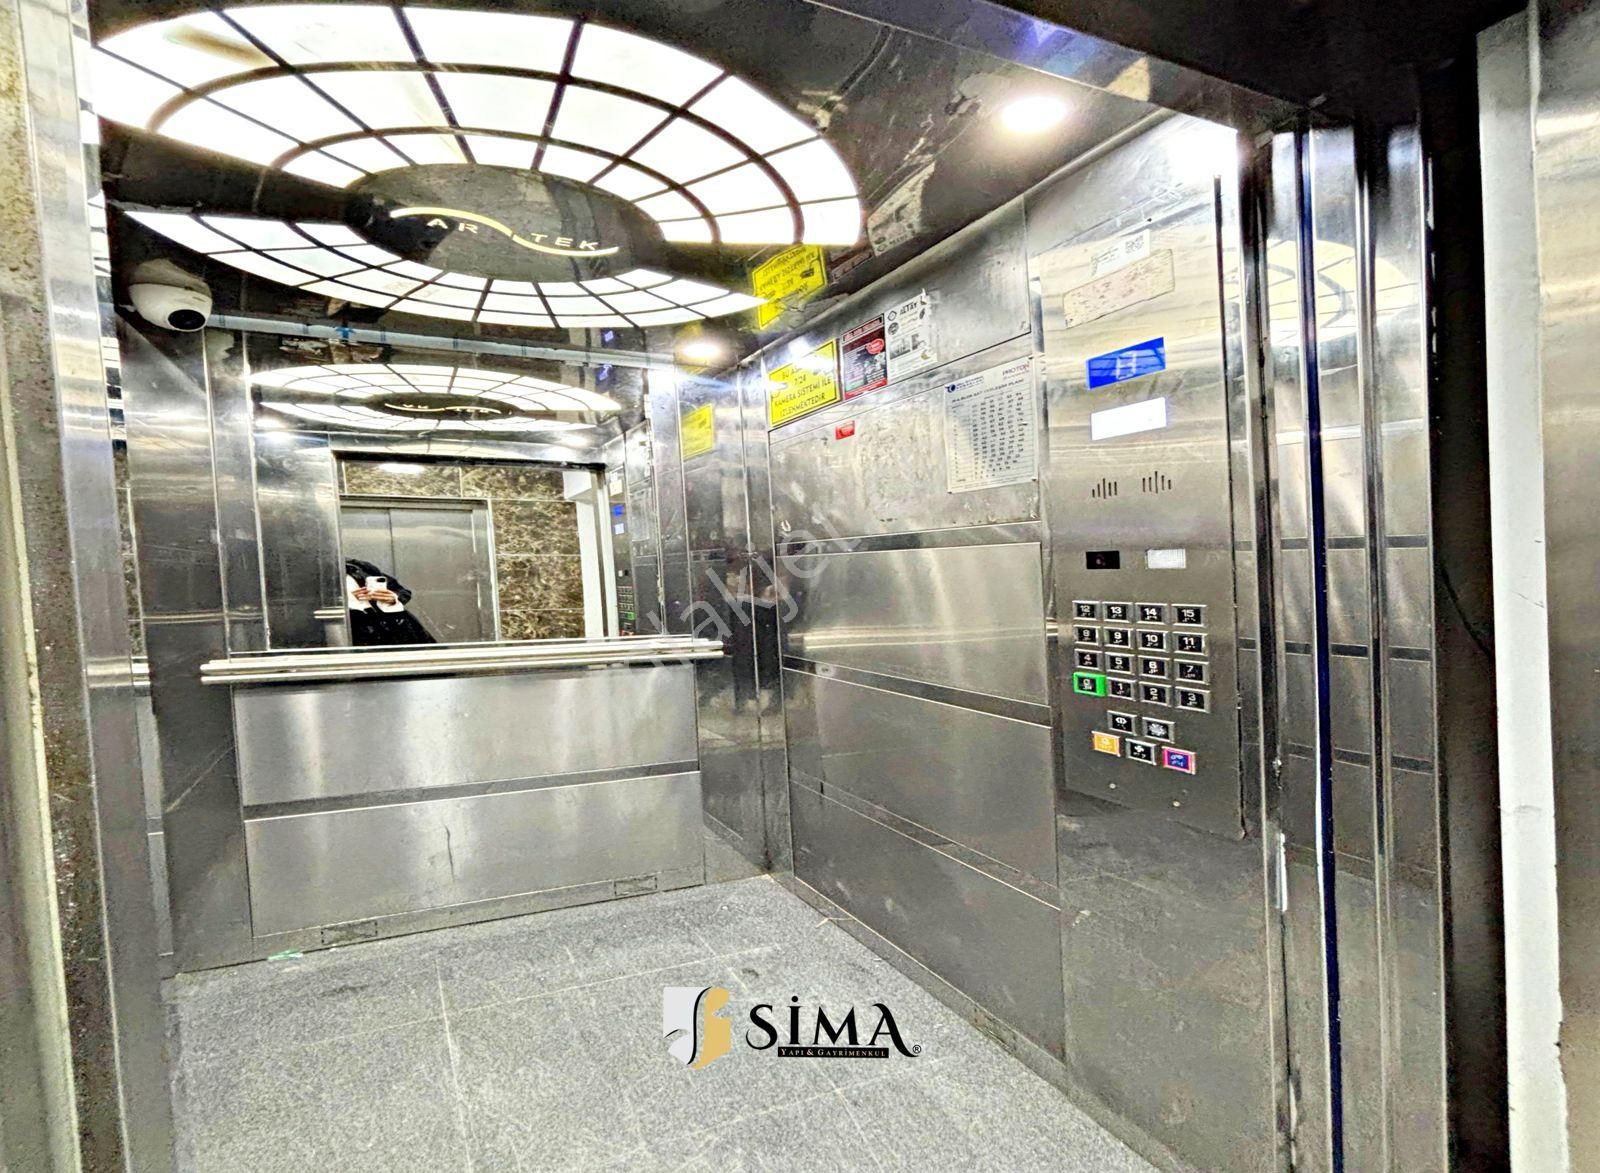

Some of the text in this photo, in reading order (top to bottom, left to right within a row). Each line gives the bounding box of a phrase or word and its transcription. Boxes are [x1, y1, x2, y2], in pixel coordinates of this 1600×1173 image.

[1080, 605, 1091, 613] 12
[1110, 606, 1122, 614] 13
[1144, 608, 1157, 616] 14
[1181, 609, 1195, 618] 15
[1114, 631, 1122, 640] 9
[1146, 634, 1158, 643] 10
[1183, 637, 1195, 646] 11
[1115, 657, 1122, 665] 5
[1148, 661, 1157, 669] 6
[1186, 665, 1194, 673] 7
[1149, 687, 1158, 696] 2
[1188, 693, 1196, 701] 3
